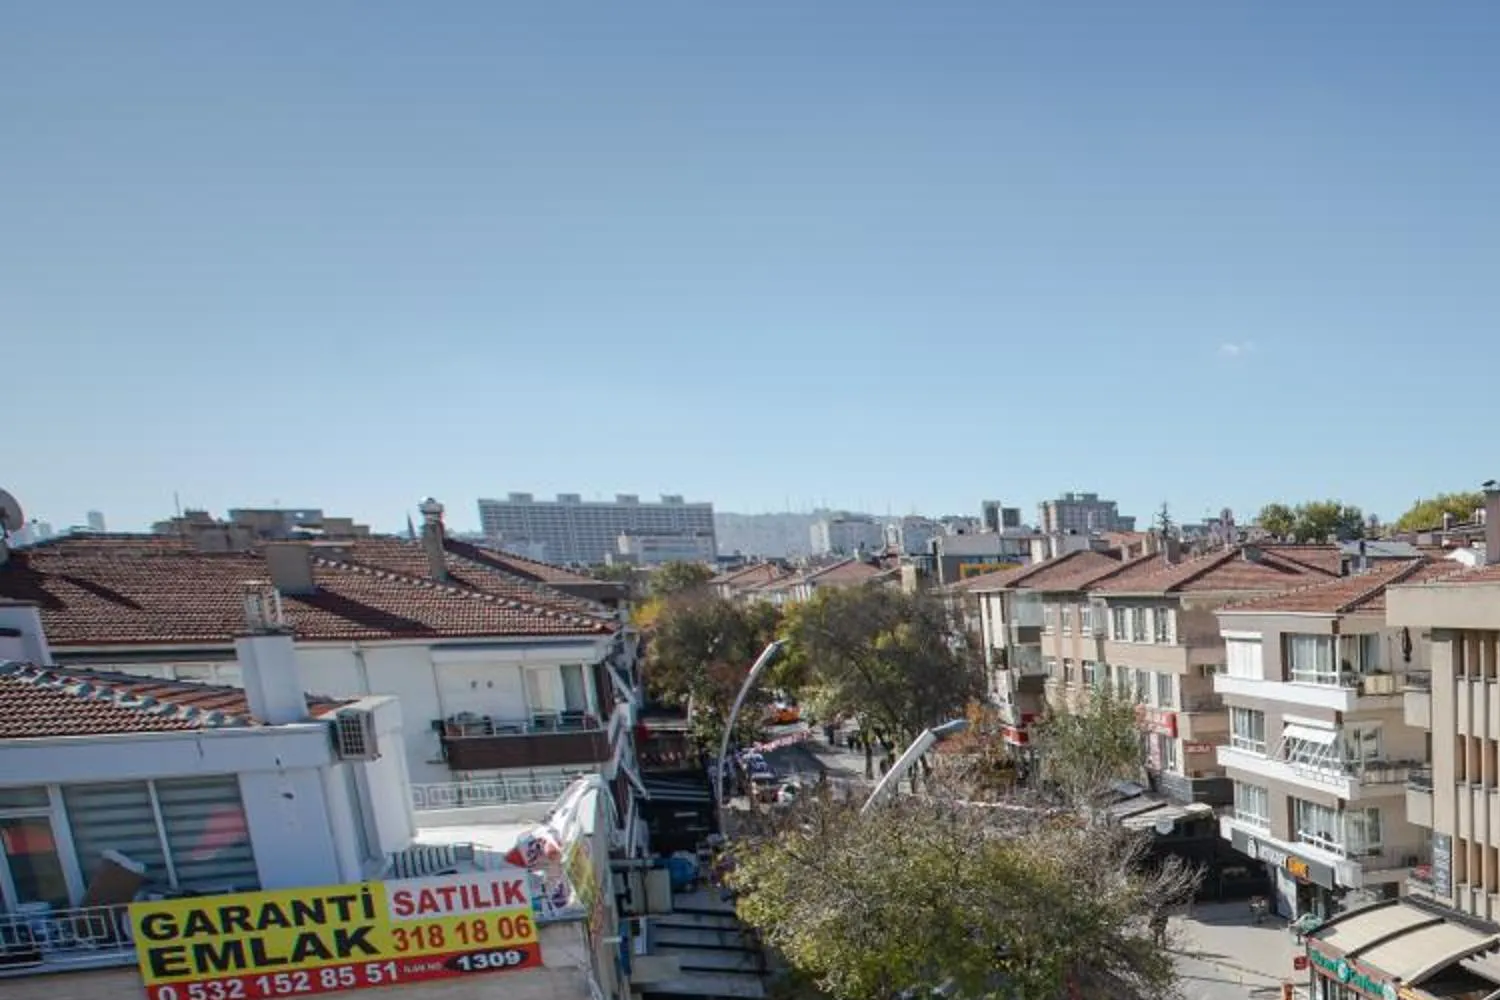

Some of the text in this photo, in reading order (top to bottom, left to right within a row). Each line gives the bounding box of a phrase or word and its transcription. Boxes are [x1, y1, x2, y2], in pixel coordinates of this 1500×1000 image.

[141, 887, 376, 940] GARANTİ
[393, 880, 526, 916] SATILIK
[149, 925, 382, 978] EMLAK
[392, 914, 532, 953] 318 18 06
[256, 971, 312, 996] 152
[320, 965, 356, 988] 85
[365, 960, 398, 984] 51
[457, 951, 521, 971] 1309
